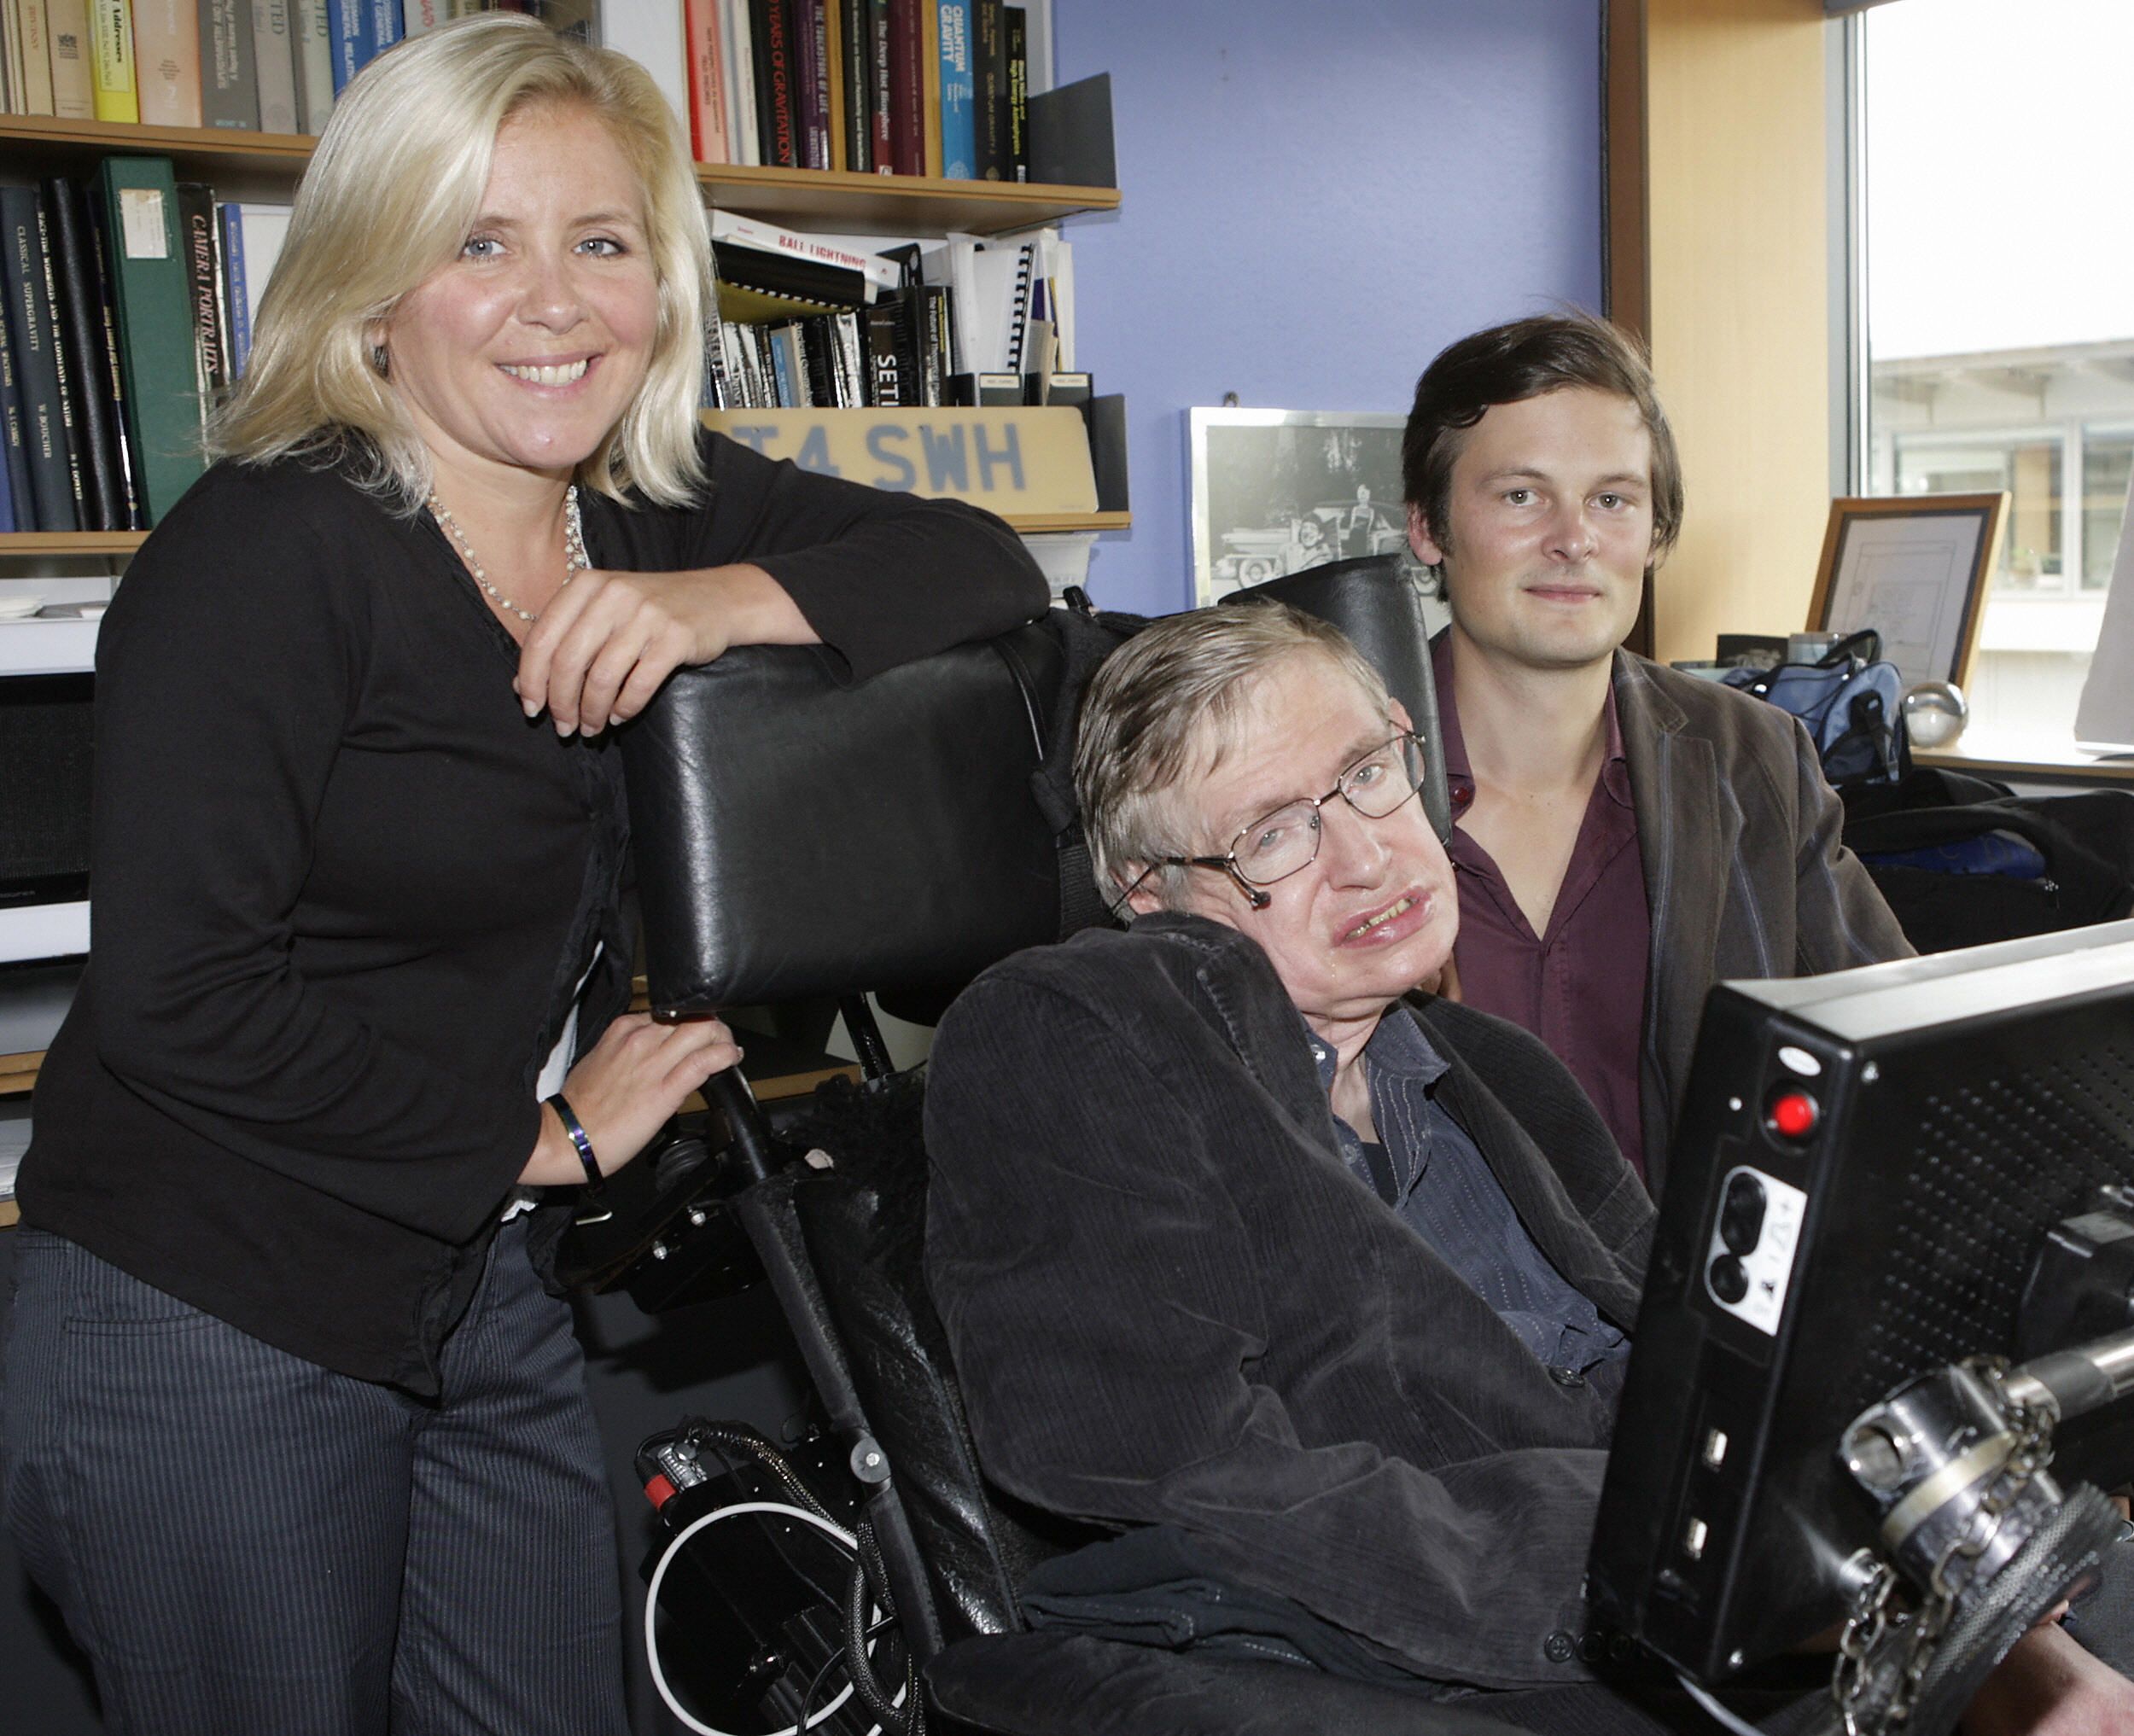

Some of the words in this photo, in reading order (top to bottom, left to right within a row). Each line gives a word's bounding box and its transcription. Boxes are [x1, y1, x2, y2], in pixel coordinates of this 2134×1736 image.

[114, 9, 123, 64] Addresses
[315, 1, 329, 38] TED
[769, 7, 783, 49] YEARS
[878, 20, 888, 38] The
[941, 4, 955, 62] GRAVITY
[953, 5, 965, 72] QUANTUM
[772, 51, 784, 69] OF
[878, 40, 888, 67] Deep
[1009, 59, 1018, 78] High
[879, 69, 889, 87] Hot
[1010, 79, 1019, 105] Energy
[773, 71, 791, 163] GRAVITATION
[819, 94, 828, 114] LIFE
[879, 90, 890, 140] Biosphere
[1012, 106, 1021, 155] Astrophysics
[17, 226, 32, 274] CLASSICAL
[38, 212, 50, 253] SPACE-TIME
[192, 215, 211, 282] CAMERA
[779, 235, 804, 252] BALL
[810, 244, 867, 270] LIGHTNING
[44, 257, 55, 300] WORMHOLES
[23, 282, 39, 352] SUPERGRAVITY
[50, 304, 59, 321] AND
[929, 296, 937, 309] The
[929, 310, 938, 334] Future
[197, 286, 219, 376] PORTRAITS
[930, 334, 939, 342] of
[55, 341, 66, 383] CONSTANTS
[878, 354, 900, 406] SETI
[930, 343, 940, 382] Theoretical
[61, 386, 67, 395] OF
[62, 400, 73, 428] NATURE
[866, 423, 1028, 494] SWH
